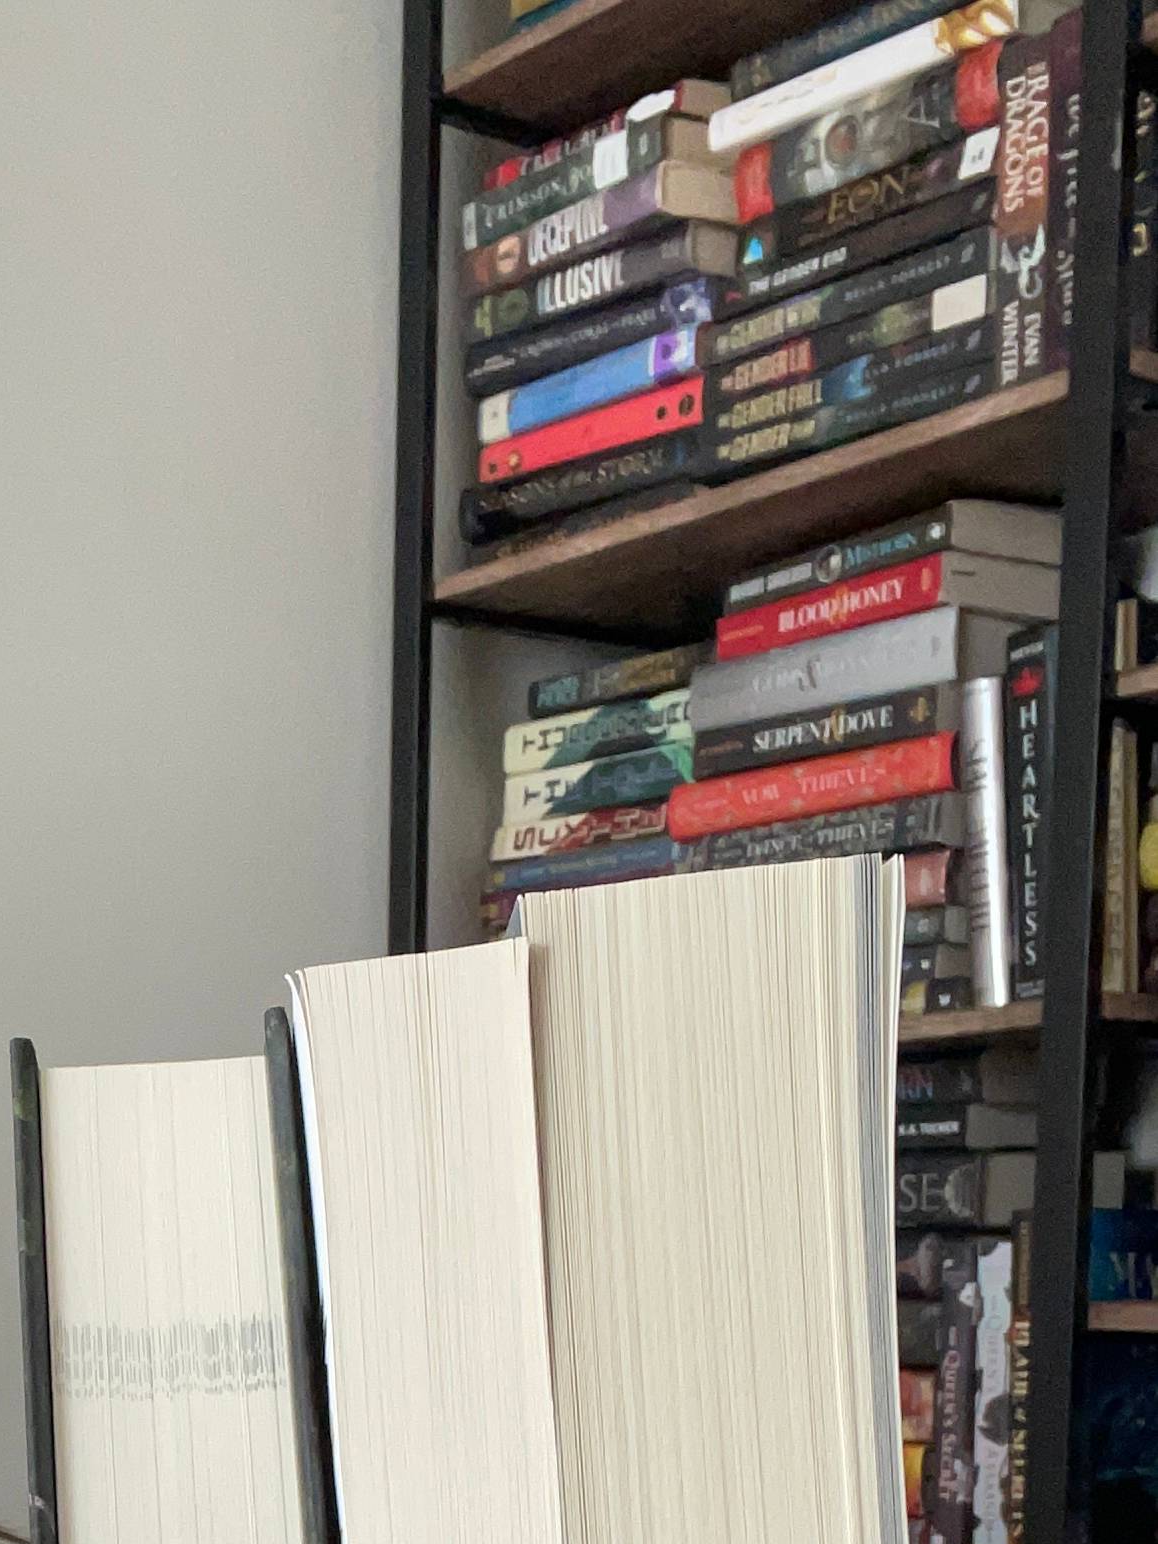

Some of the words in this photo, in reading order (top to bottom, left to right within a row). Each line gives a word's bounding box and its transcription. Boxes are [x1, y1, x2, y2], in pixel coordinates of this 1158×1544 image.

[1002, 75, 1027, 213] DRAGONS
[1025, 74, 1050, 157] RAGE
[1023, 311, 1042, 368] EVAN
[845, 577, 907, 613] HONEY
[751, 714, 831, 754] SERPENT
[839, 704, 894, 737] DOVE
[1018, 698, 1042, 968] HEARTLESS
